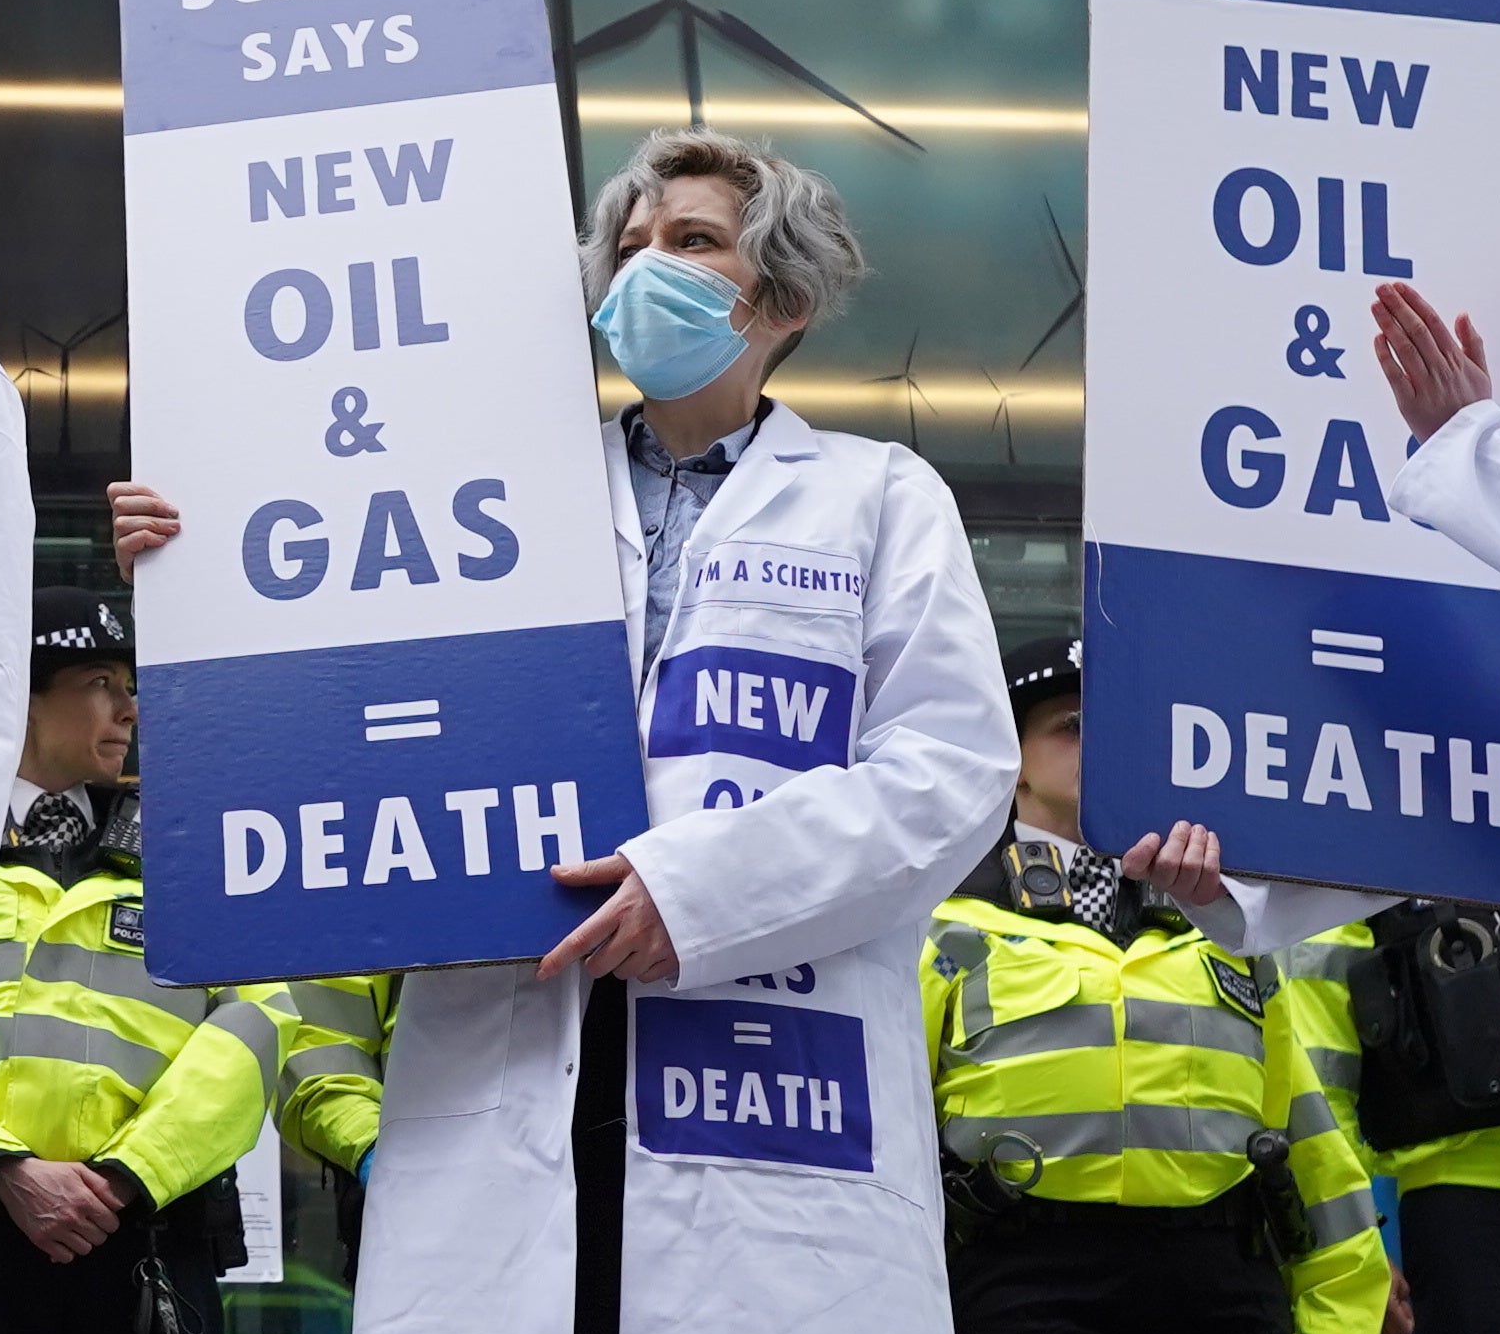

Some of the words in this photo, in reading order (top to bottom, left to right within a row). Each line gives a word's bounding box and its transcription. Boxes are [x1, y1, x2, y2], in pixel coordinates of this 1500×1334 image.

[241, 13, 420, 82] SAYS
[1222, 43, 1430, 130] NEW
[247, 137, 454, 223] NEW
[1211, 166, 1414, 280] OIL
[244, 255, 450, 362] OIL
[1286, 304, 1346, 379] &
[324, 385, 386, 458] &
[1201, 405, 1439, 530] GA
[241, 477, 521, 602] GAS
[733, 560, 748, 582] A
[762, 560, 861, 597] SCIENTIS
[695, 668, 829, 742] NEW
[222, 780, 586, 897] DEATH
[113, 927, 144, 941] POLIC
[663, 1066, 843, 1134] DEATH
